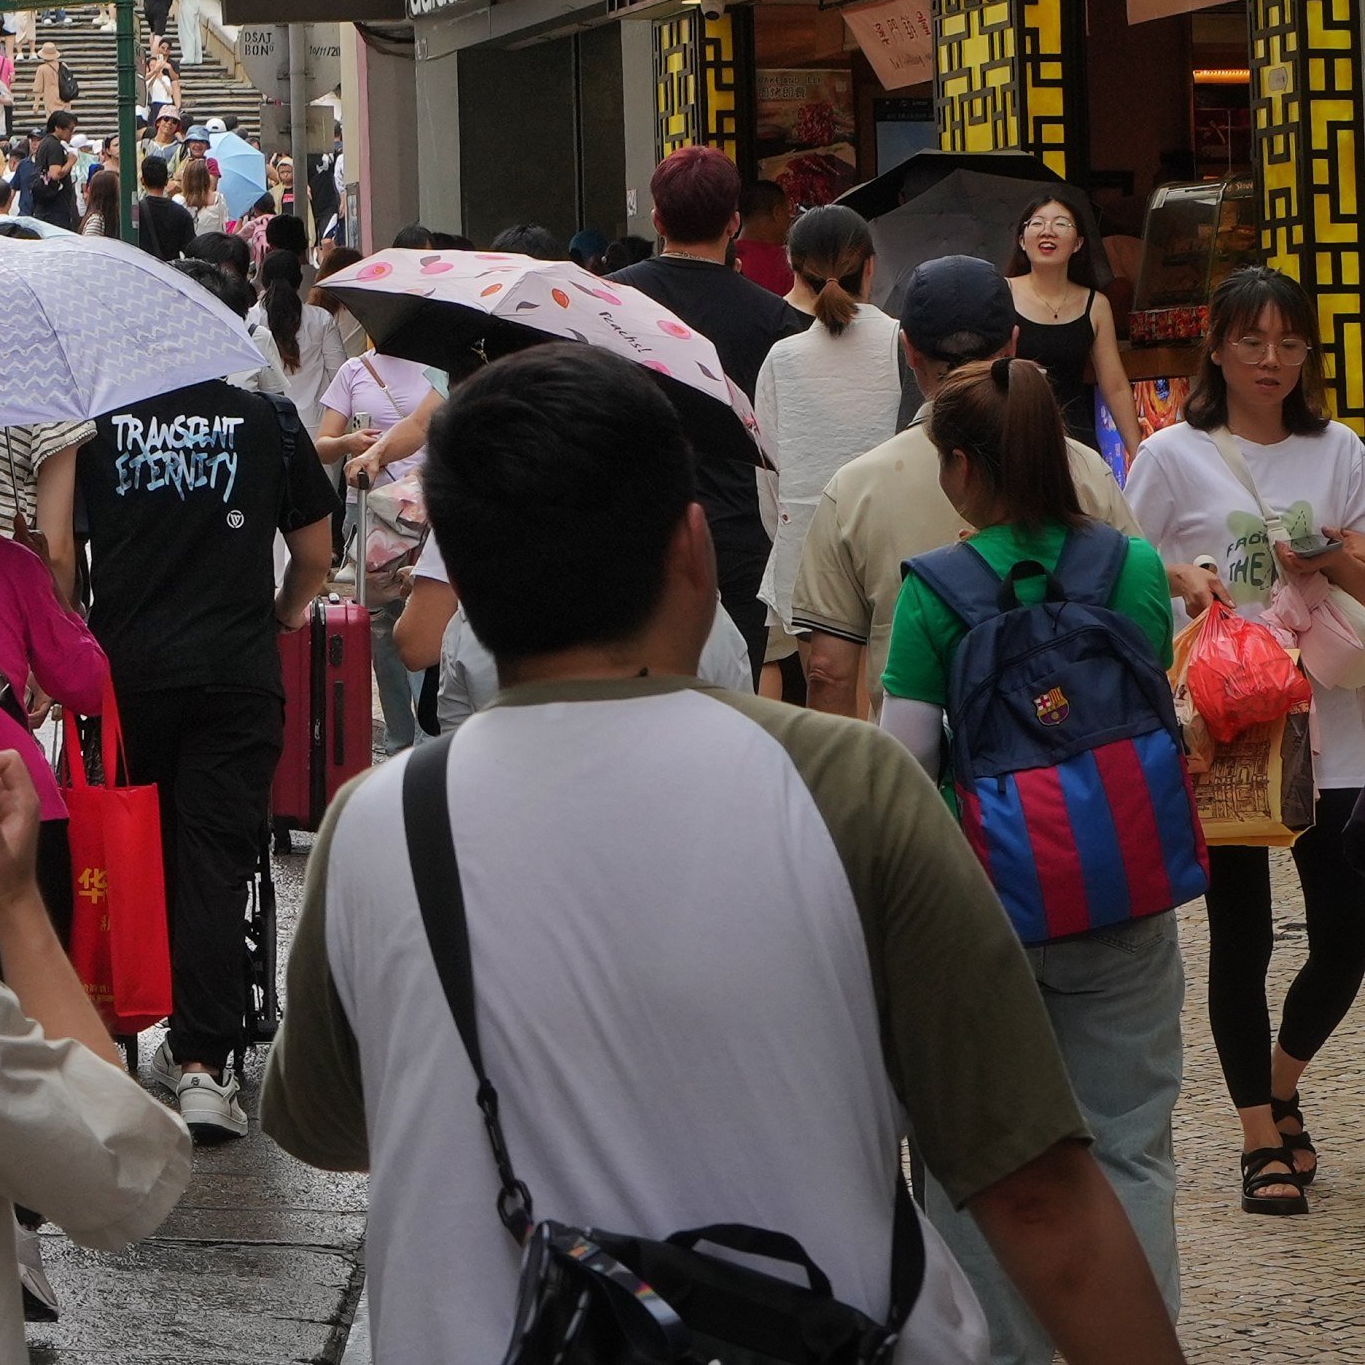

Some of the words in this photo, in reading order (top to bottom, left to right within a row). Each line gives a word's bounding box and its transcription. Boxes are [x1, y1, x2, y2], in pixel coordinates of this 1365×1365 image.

[244, 32, 272, 43] DSAT
[116, 450, 237, 503] ETERNITY
[1230, 553, 1266, 586] THE
